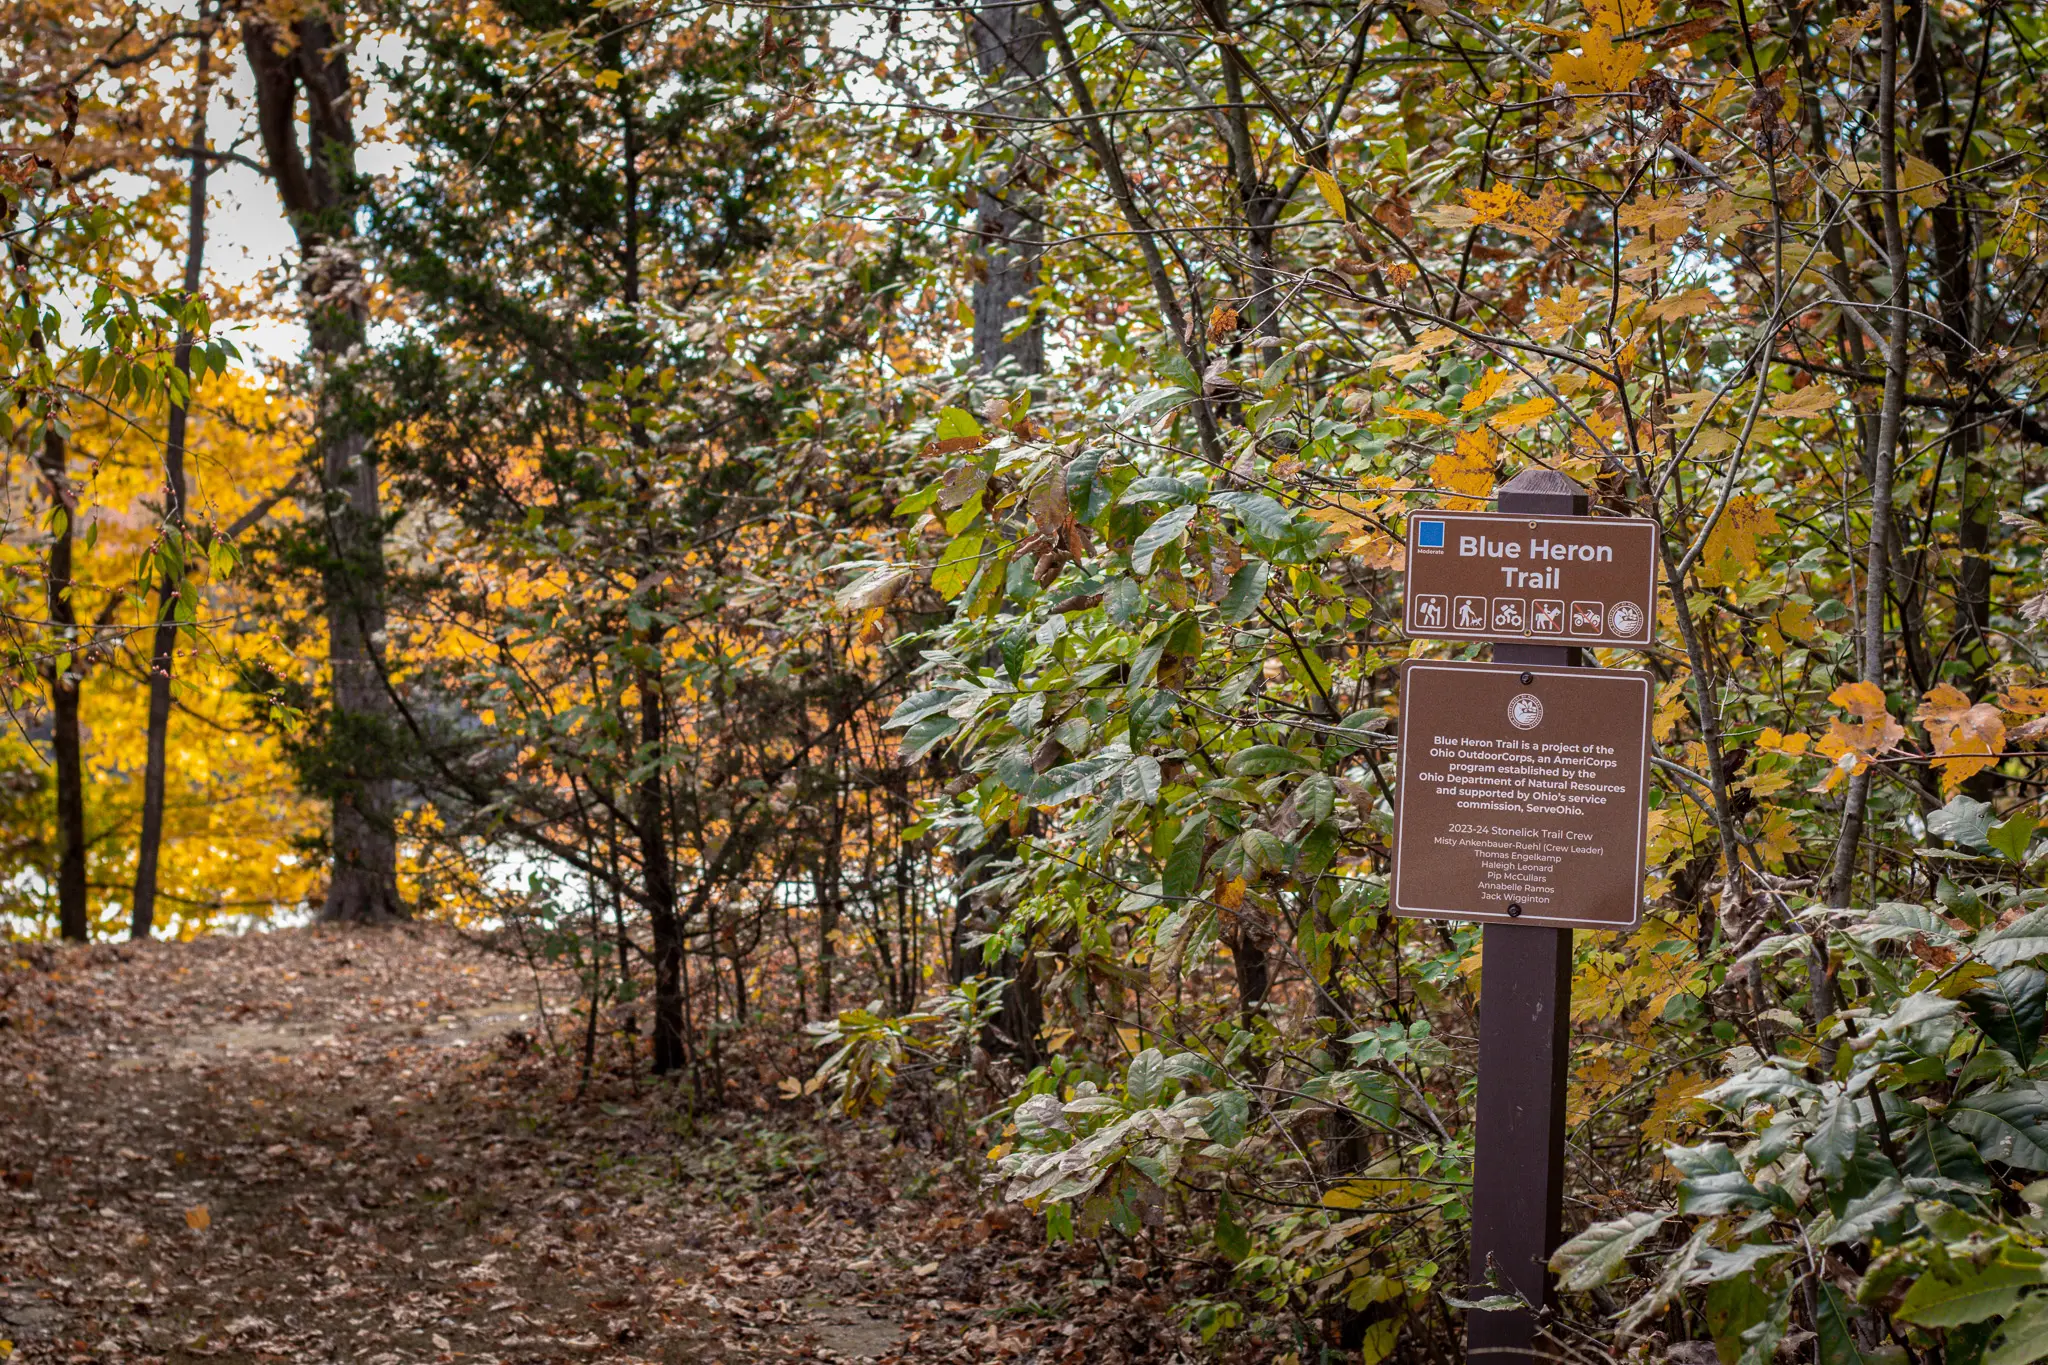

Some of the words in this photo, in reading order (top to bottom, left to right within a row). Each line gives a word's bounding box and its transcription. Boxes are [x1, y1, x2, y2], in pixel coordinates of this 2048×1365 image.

[1459, 536, 1521, 558] Blue
[1530, 539, 1612, 562] Heron
[1501, 566, 1560, 589] Trail
[1434, 736, 1458, 746] Blue
[1461, 738, 1493, 747] Heron
[1496, 740, 1519, 749] Trail
[1521, 740, 1530, 750] is
[1542, 742, 1580, 754] project
[1582, 744, 1594, 753] of
[1596, 745, 1614, 754] the
[1430, 748, 1455, 758] Ohio
[1458, 750, 1535, 764] OutdoorCorps,
[1553, 755, 1617, 769] AmeriCorps
[1449, 763, 1495, 773] program
[1498, 765, 1559, 776] established
[1562, 768, 1575, 779] by
[1578, 769, 1596, 778] the
[1419, 772, 1444, 782] Ohio
[1447, 774, 1512, 786] Department
[1514, 778, 1526, 787] of
[1528, 779, 1567, 789] Natural
[1570, 781, 1625, 793] Resources
[1436, 786, 1456, 795] and
[1459, 789, 1514, 799] supported
[1517, 790, 1530, 801] by
[1568, 794, 1607, 804] service
[1457, 800, 1524, 813] commission,
[1526, 804, 1584, 815] ServeOhio.
[1448, 823, 1489, 834] 2023-24
[1491, 826, 1539, 837] Stonelick
[1541, 829, 1563, 839] Trail
[1566, 831, 1593, 841] Crew
[1434, 837, 1457, 847] Misty
[1459, 838, 1541, 850] Ankenbauer-Ruehl
[1543, 843, 1569, 852] (Crew
[1571, 846, 1603, 856] Leader)
[1474, 849, 1509, 859] Thomas
[1511, 852, 1562, 864] Engelkamp
[1481, 861, 1515, 871] Haleigh
[1517, 863, 1553, 872] Leonard
[1487, 871, 1502, 880] Pip
[1504, 872, 1546, 882] McCullars
[1478, 881, 1523, 891] Annabelle
[1524, 884, 1555, 893] Ramos
[1481, 892, 1502, 900] Jack
[1503, 893, 1550, 904] Wigginton
